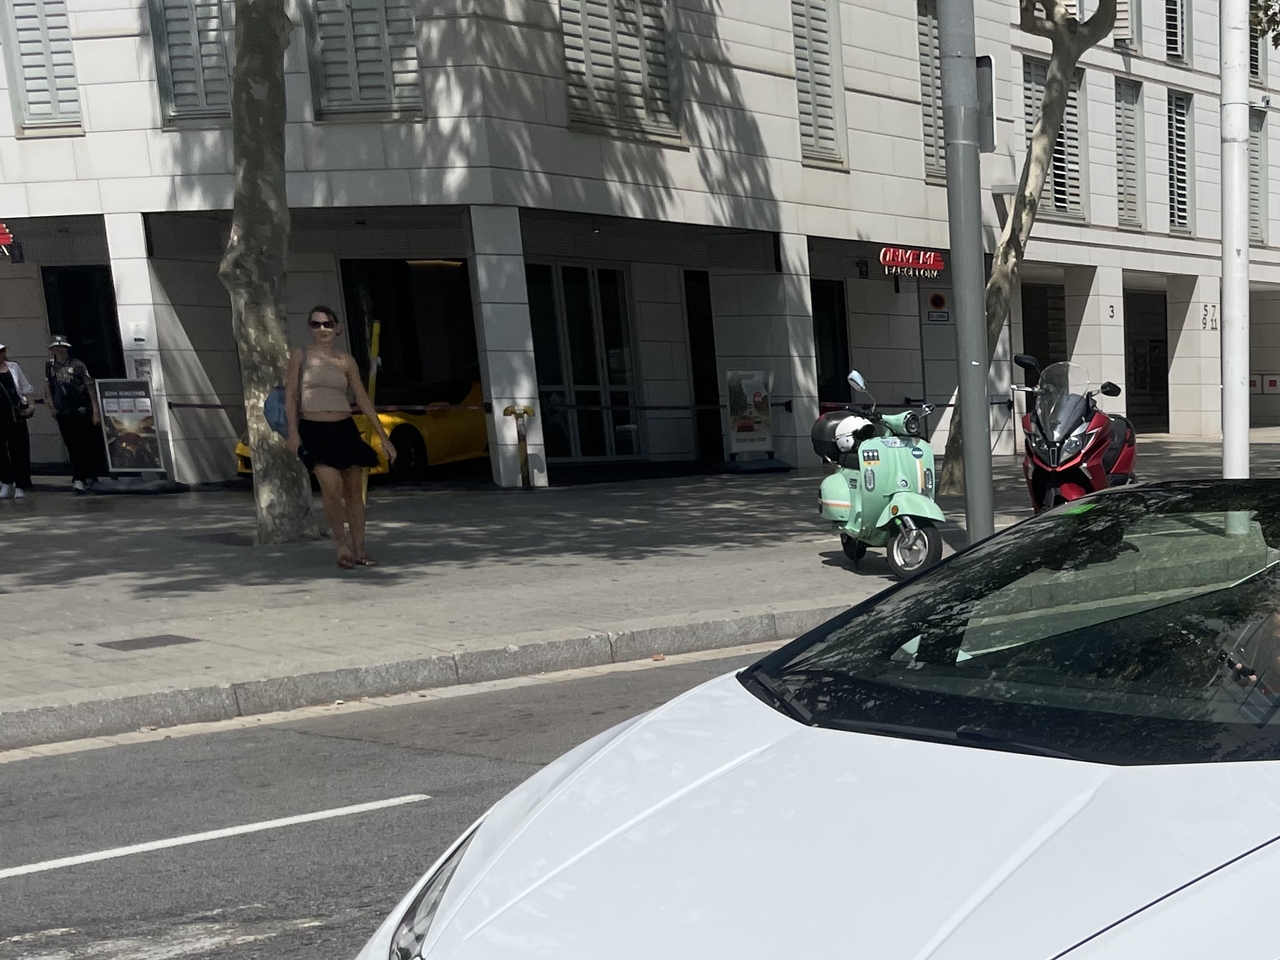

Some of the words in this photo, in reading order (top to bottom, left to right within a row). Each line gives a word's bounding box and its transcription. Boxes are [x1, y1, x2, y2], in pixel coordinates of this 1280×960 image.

[1109, 305, 1114, 318] 3
[1203, 305, 1208, 317] 5
[1211, 305, 1217, 317] 7
[1202, 317, 1207, 329] 9
[1211, 317, 1218, 330] 11
